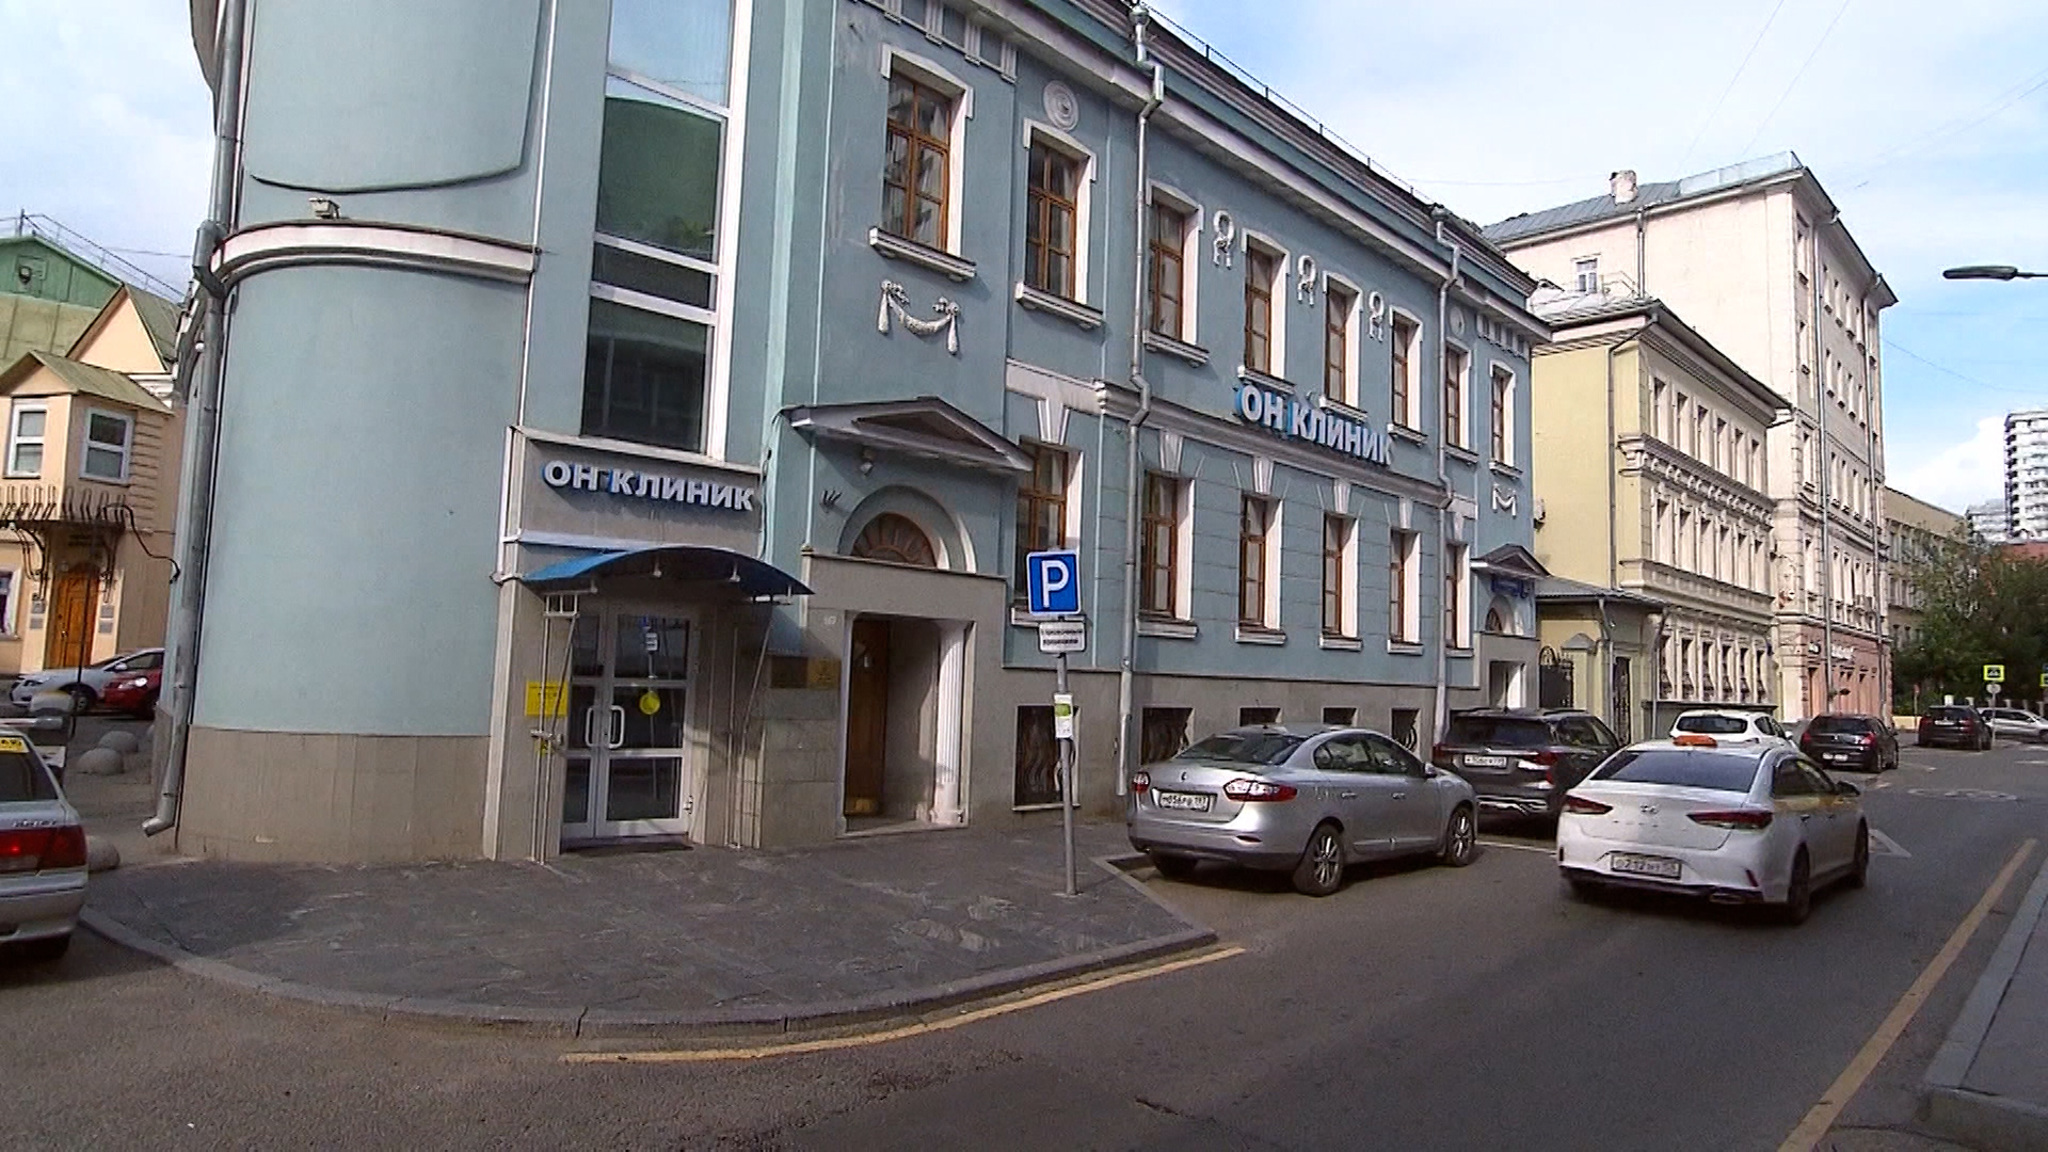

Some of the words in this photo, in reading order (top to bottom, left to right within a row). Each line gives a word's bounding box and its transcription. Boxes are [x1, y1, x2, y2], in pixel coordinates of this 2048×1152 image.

[1237, 384, 1284, 431] ОН
[1288, 400, 1393, 466] КЛИНИК
[542, 460, 599, 491] ОН
[609, 467, 754, 511] КЛИНИК
[1041, 559, 1070, 608] P
